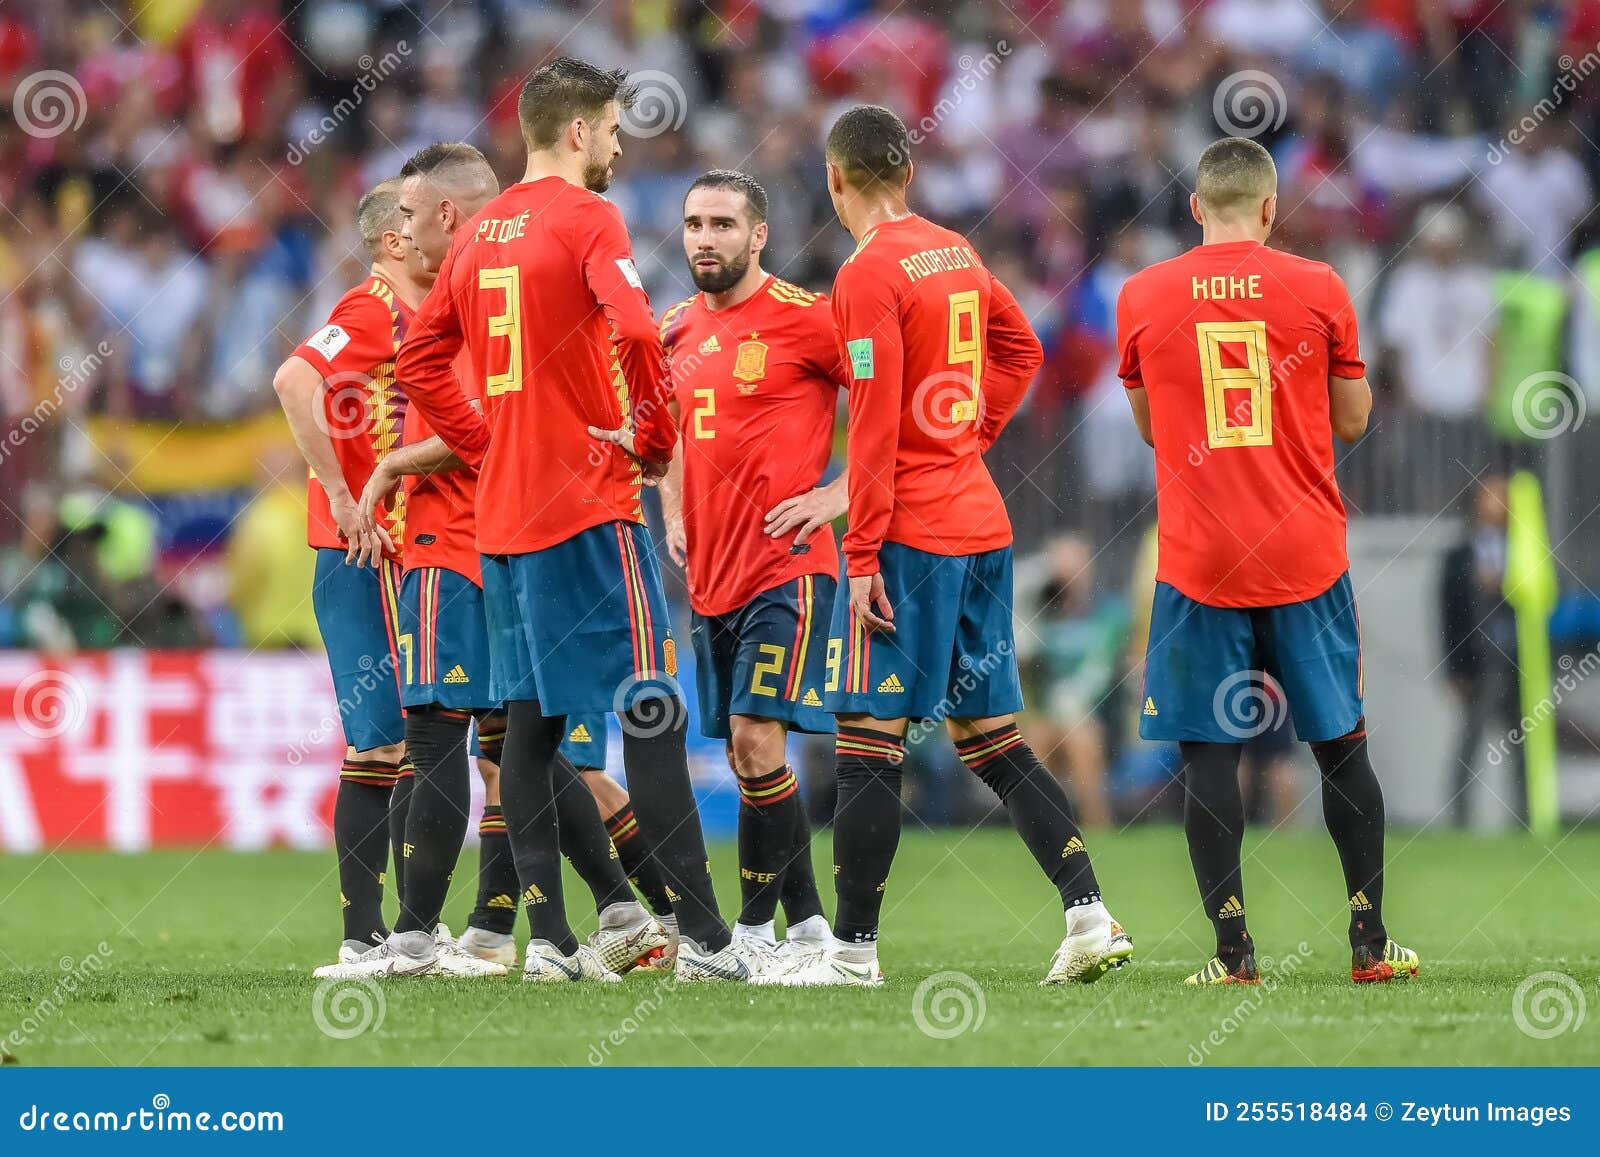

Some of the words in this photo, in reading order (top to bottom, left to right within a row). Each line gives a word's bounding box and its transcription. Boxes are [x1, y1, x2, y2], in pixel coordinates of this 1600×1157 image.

[479, 266, 522, 396] 3
[1191, 275, 1263, 300] KOKE
[947, 290, 982, 425] 9
[1196, 321, 1273, 450] 8
[693, 388, 716, 440] 2
[750, 643, 786, 697] 2
